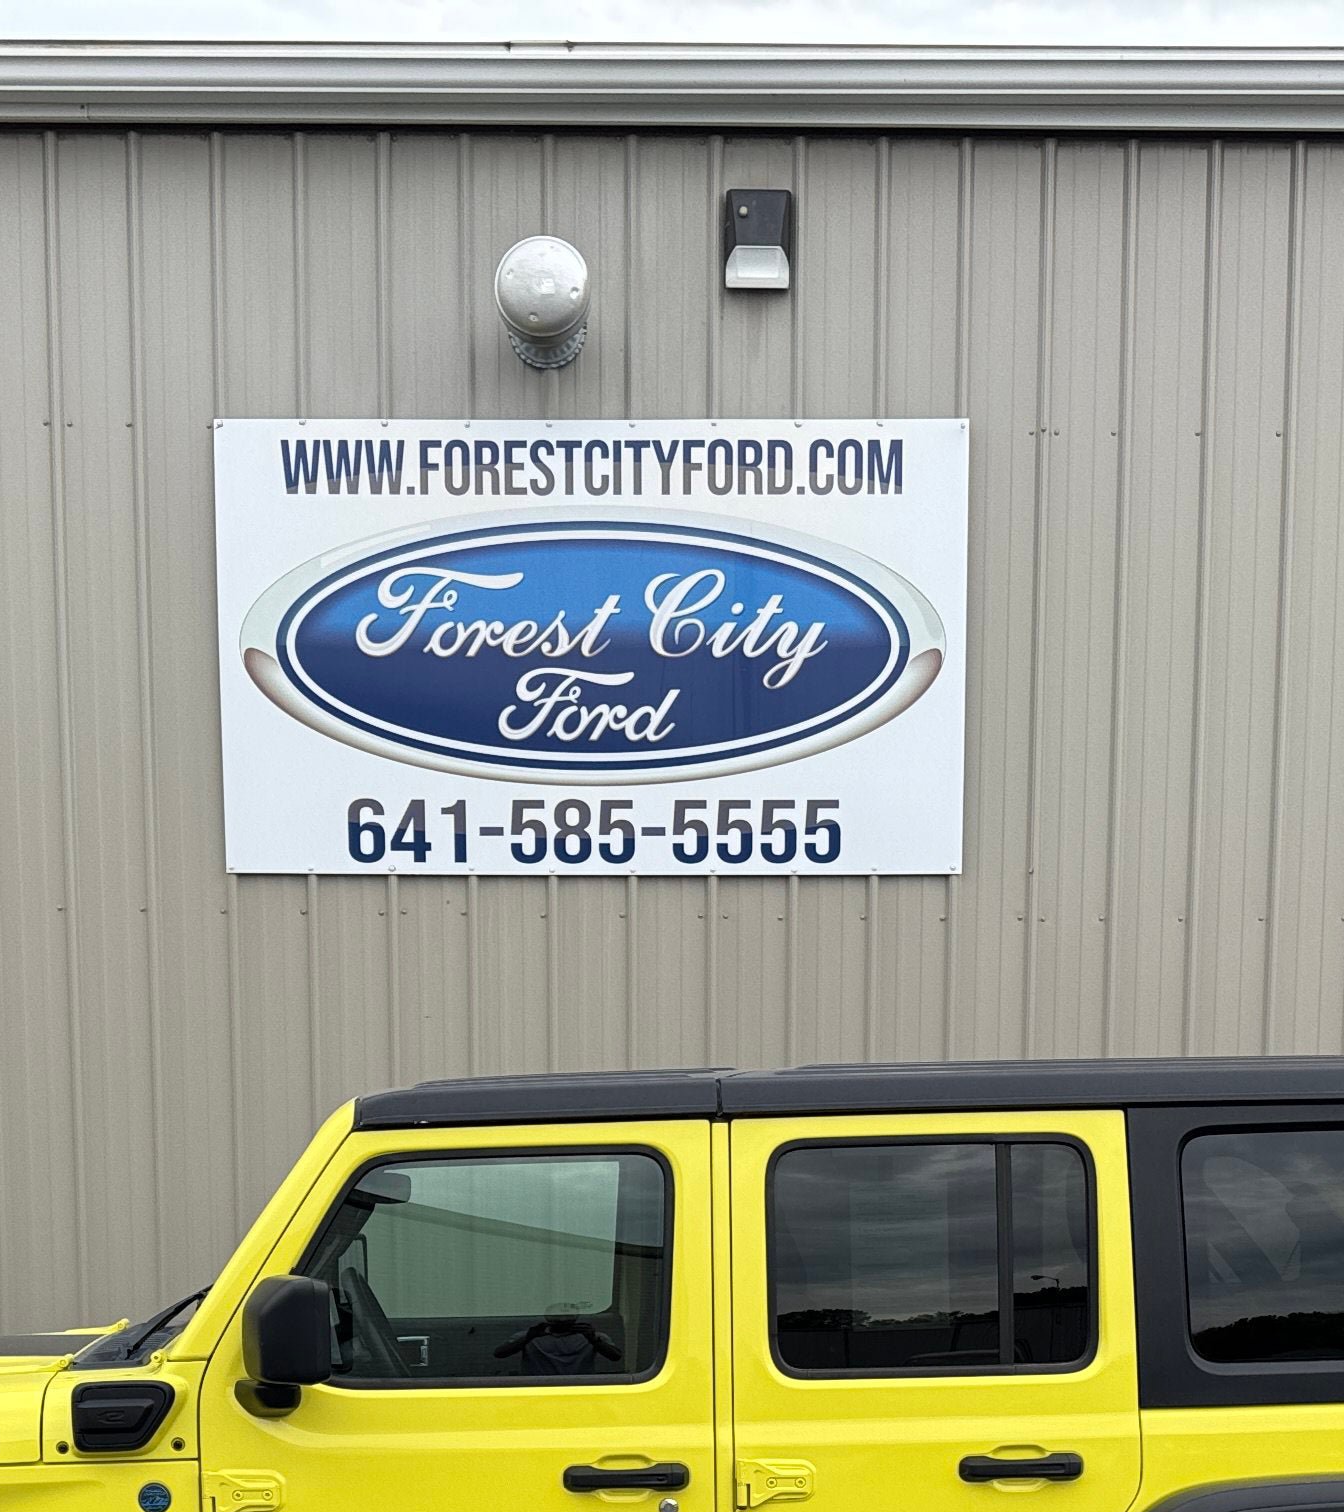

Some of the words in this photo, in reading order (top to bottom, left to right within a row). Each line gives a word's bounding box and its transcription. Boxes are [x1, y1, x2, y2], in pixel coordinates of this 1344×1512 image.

[279, 438, 904, 496] WWW.FORESTCITYFORD.COM
[354, 565, 622, 660] Forest
[644, 567, 830, 690] City
[497, 666, 681, 743] Ford
[346, 797, 842, 865] 641-585-5555
